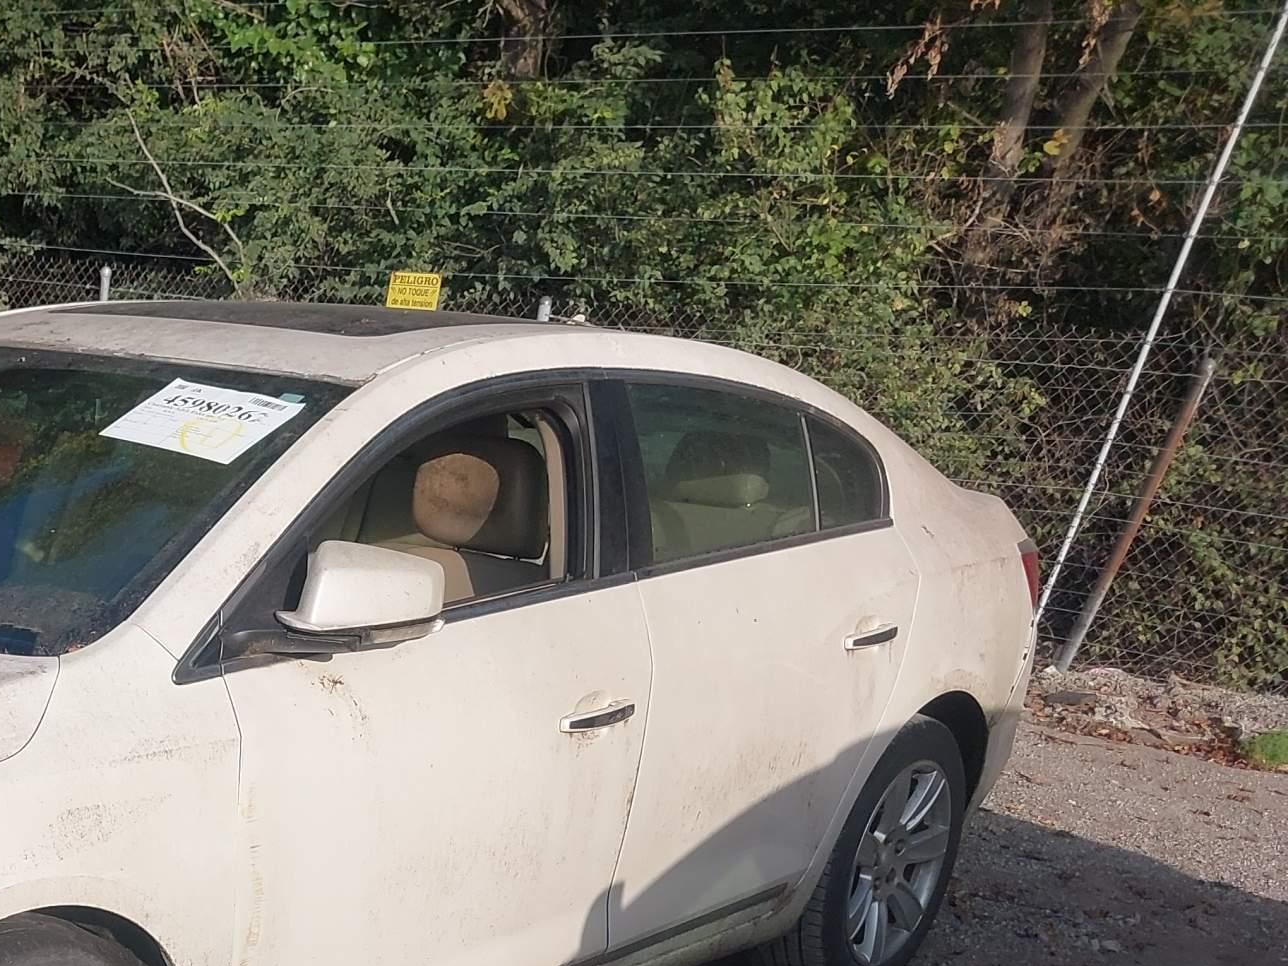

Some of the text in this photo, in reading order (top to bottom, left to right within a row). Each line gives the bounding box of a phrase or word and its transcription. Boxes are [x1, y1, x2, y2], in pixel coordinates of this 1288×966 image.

[392, 274, 439, 286] PELIGRO
[398, 287, 430, 297] NO TOQUE
